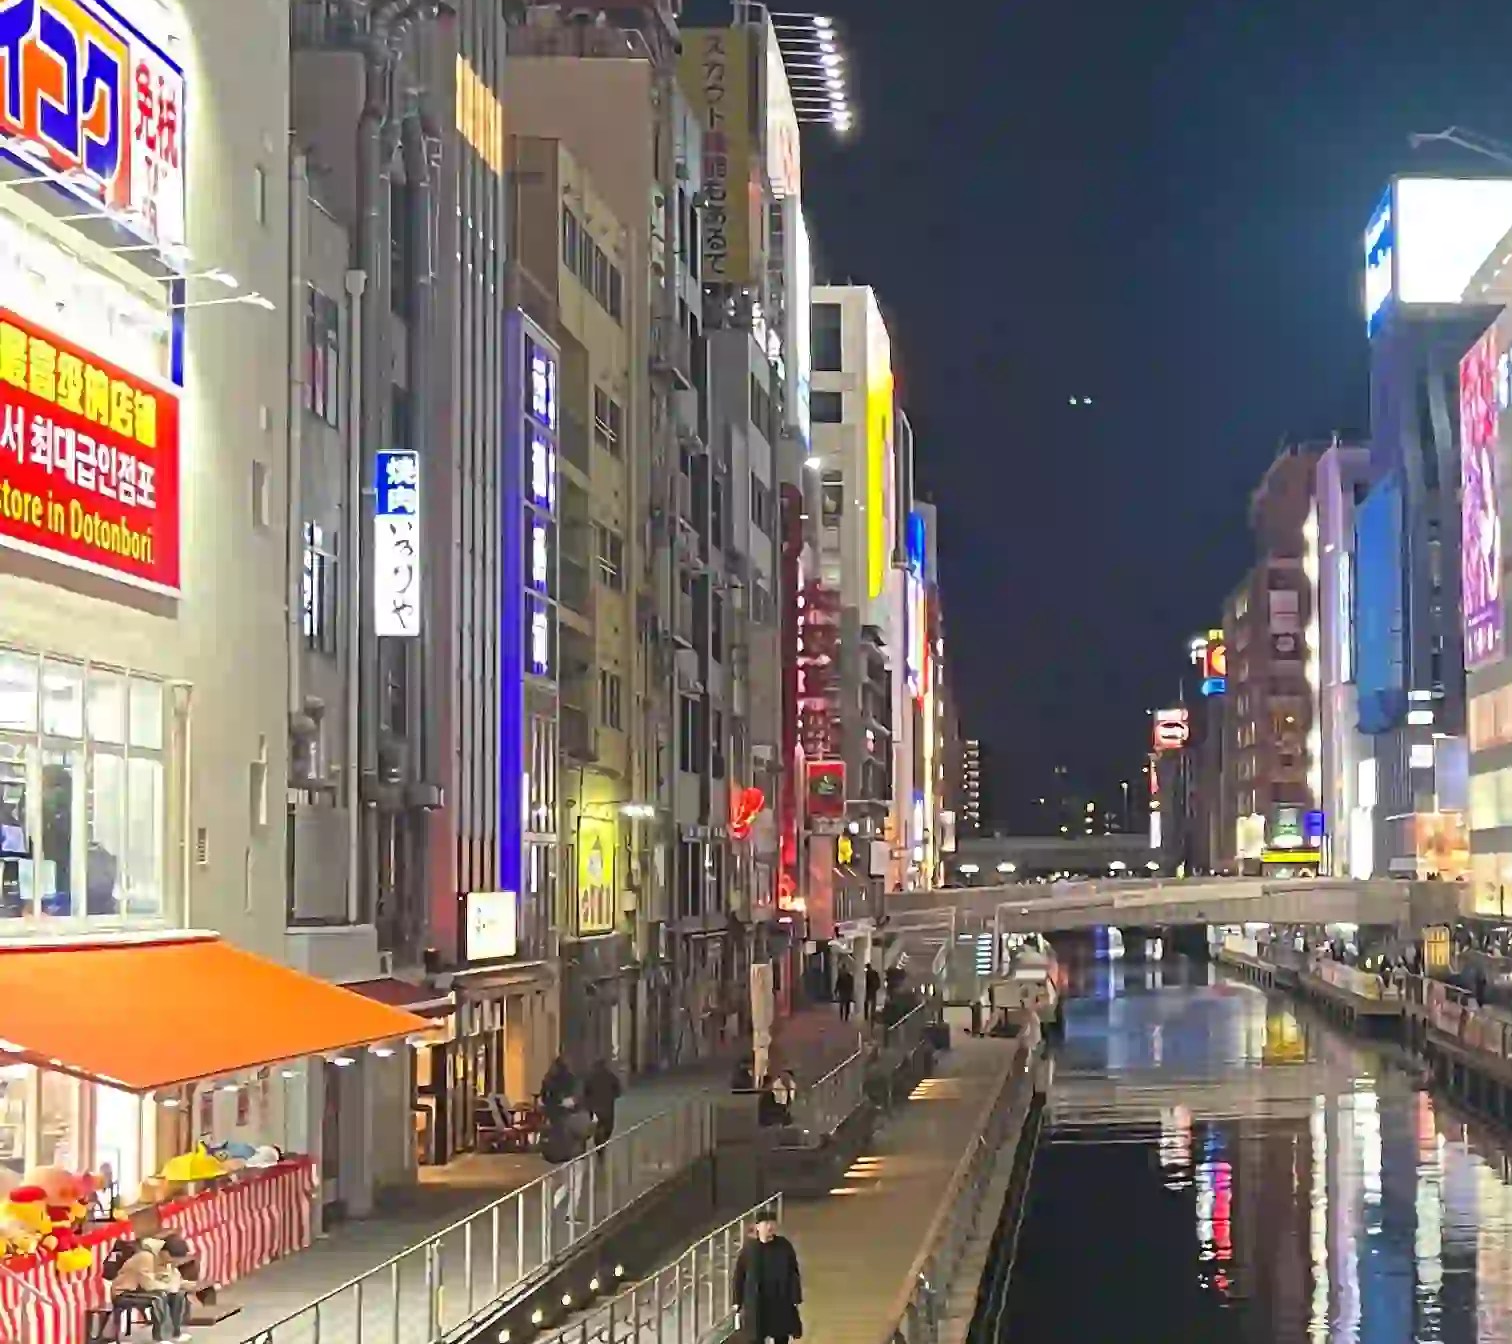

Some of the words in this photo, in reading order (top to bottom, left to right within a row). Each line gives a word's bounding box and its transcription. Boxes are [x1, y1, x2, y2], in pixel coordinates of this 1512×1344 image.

[0, 478, 43, 528] tore
[47, 490, 66, 535] in
[388, 521, 414, 629] いろりや
